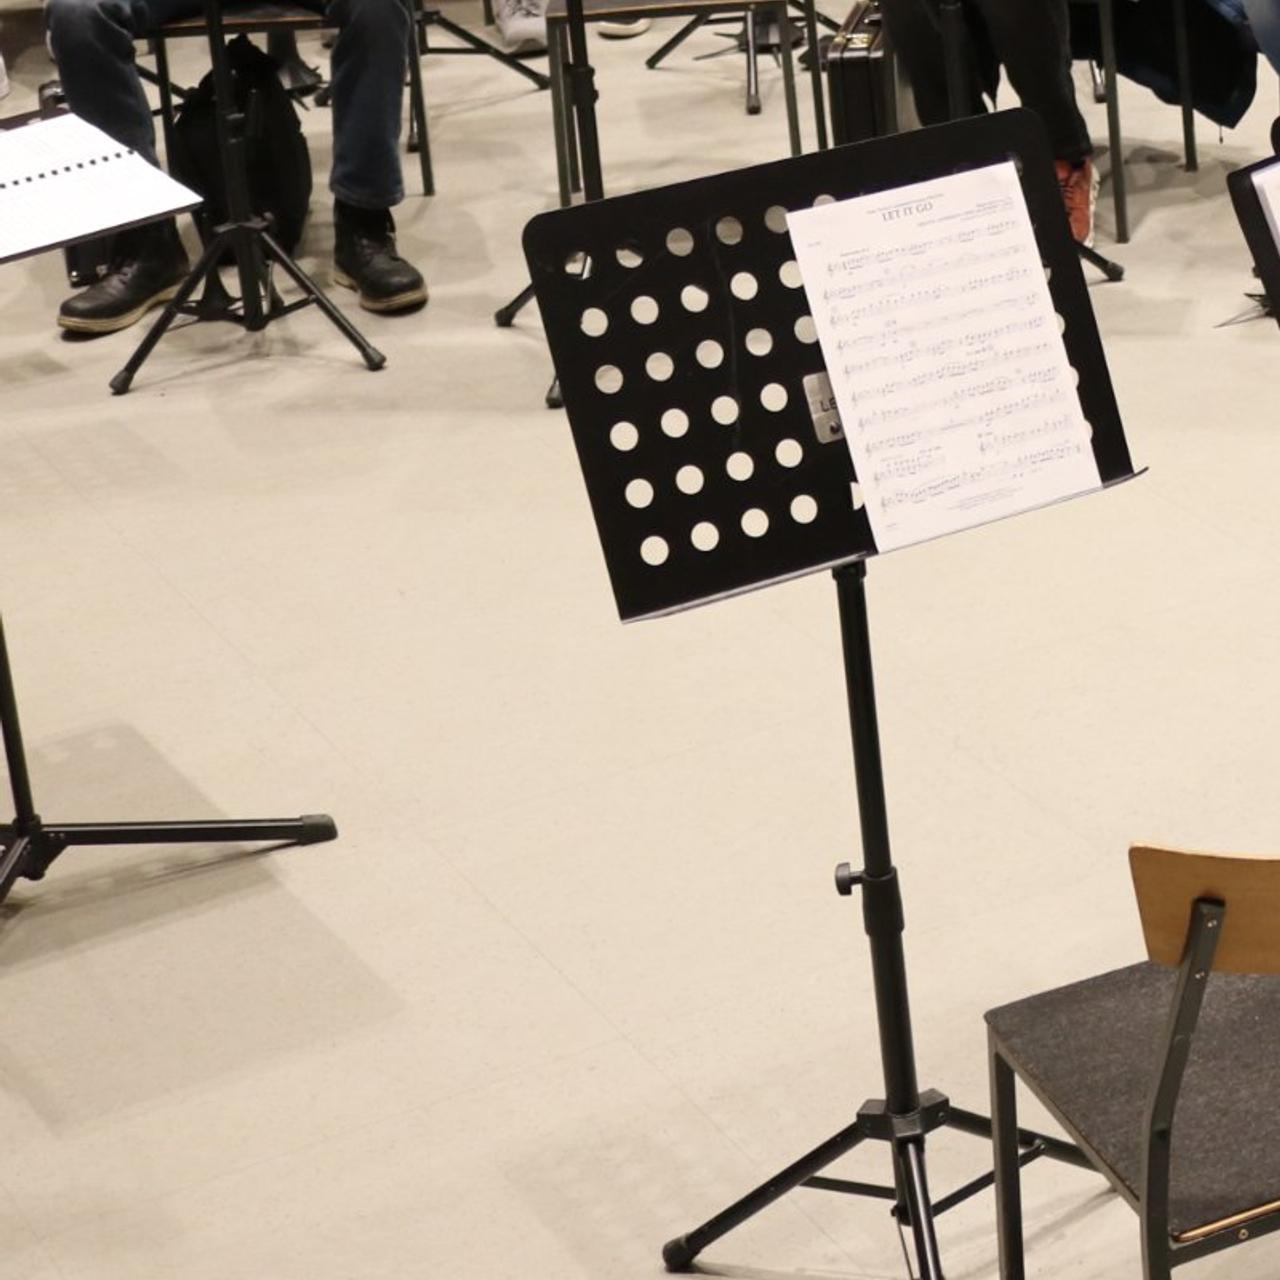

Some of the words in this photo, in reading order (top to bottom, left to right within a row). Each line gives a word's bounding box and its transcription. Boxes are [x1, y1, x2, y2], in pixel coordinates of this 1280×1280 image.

[882, 208, 902, 222] LET
[904, 205, 915, 218] IT
[916, 201, 934, 214] GO
